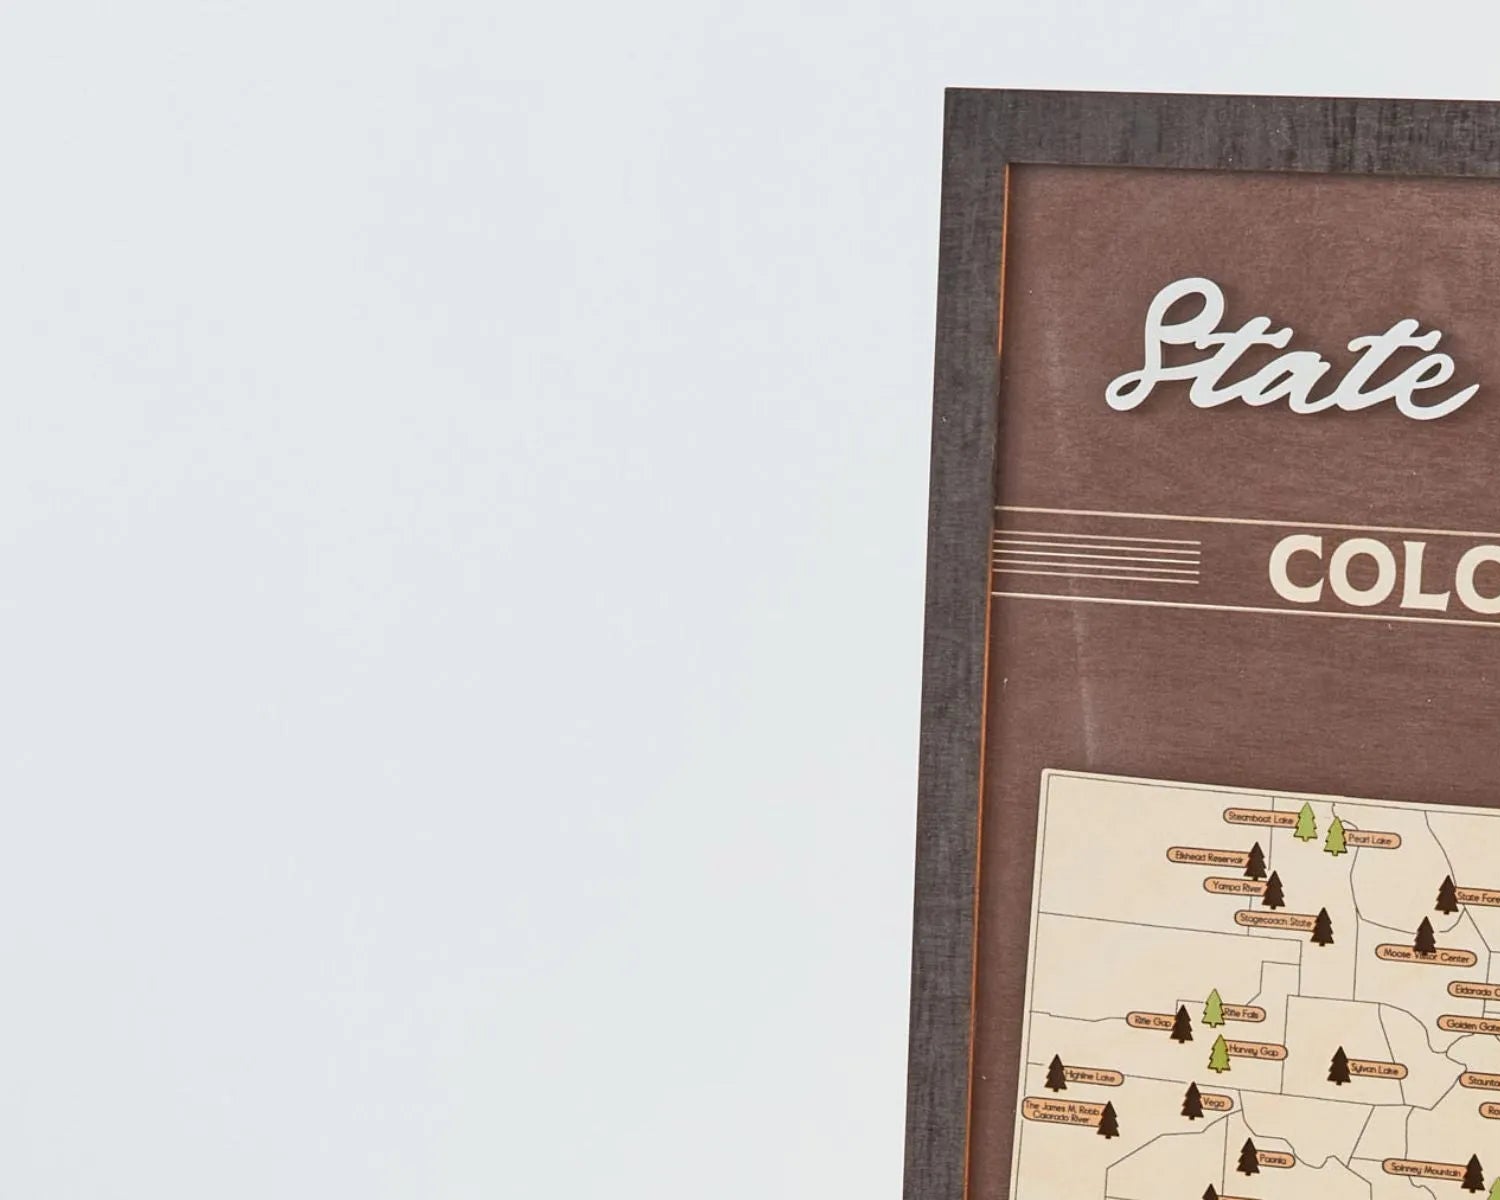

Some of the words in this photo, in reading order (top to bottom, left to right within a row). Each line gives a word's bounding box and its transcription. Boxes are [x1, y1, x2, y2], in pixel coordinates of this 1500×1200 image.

[1105, 276, 1480, 421] State
[1228, 811, 1271, 823] Steamboat
[1274, 813, 1294, 824] Lake
[1349, 833, 1370, 844] Pearl
[1372, 835, 1392, 845] Lake
[1208, 853, 1243, 864] Reservoir
[1212, 881, 1240, 892] Yampa
[1242, 883, 1262, 893] River
[1457, 892, 1479, 902] State
[1240, 913, 1287, 925] Stagecoach
[1290, 917, 1312, 928] State
[1384, 949, 1411, 958] Moose
[1441, 952, 1470, 963] Center
[1455, 985, 1492, 996] Eldorado
[1153, 1018, 1171, 1029] Gap
[1447, 1020, 1477, 1031] Golden
[1480, 1023, 1500, 1033] Gate
[1229, 1044, 1258, 1056] Harvey
[1260, 1047, 1279, 1058] Gap
[1351, 1063, 1376, 1074] Sylvan
[1378, 1065, 1398, 1075] Lake
[1096, 1072, 1115, 1081] Lake
[1026, 1100, 1040, 1109] The
[1042, 1102, 1065, 1112] James
[1202, 1097, 1225, 1109] Vega
[1033, 1110, 1069, 1121] Colorado
[1071, 1113, 1089, 1123] River
[1391, 1162, 1422, 1175] Spinney
[1424, 1166, 1461, 1177] Mountain
